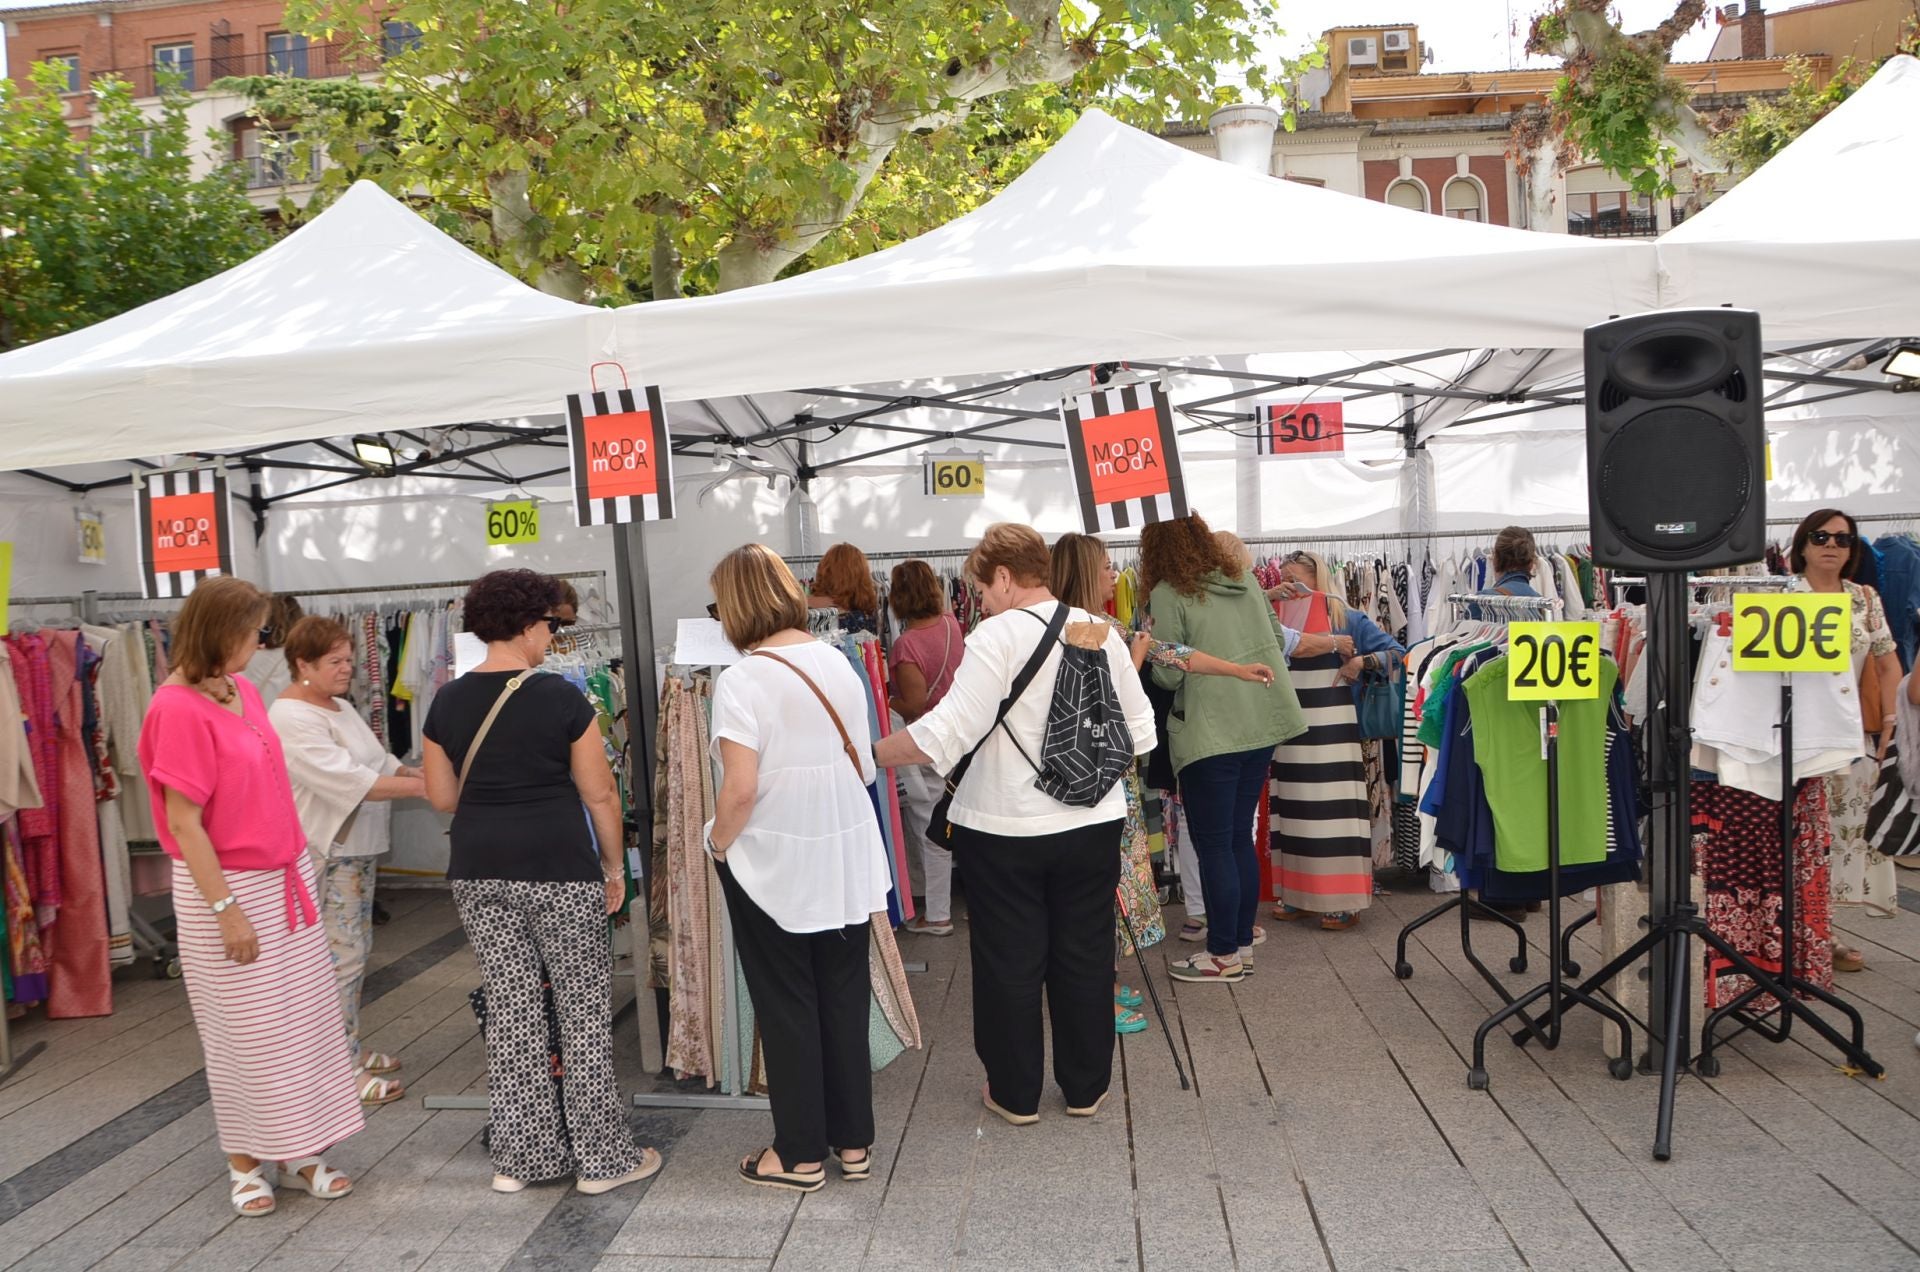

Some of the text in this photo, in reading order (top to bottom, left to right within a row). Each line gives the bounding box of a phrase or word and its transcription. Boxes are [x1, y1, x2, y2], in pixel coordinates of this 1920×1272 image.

[488, 509, 537, 539] 60%
[1739, 605, 1844, 660] 20€
[1513, 634, 1594, 688] 20€
